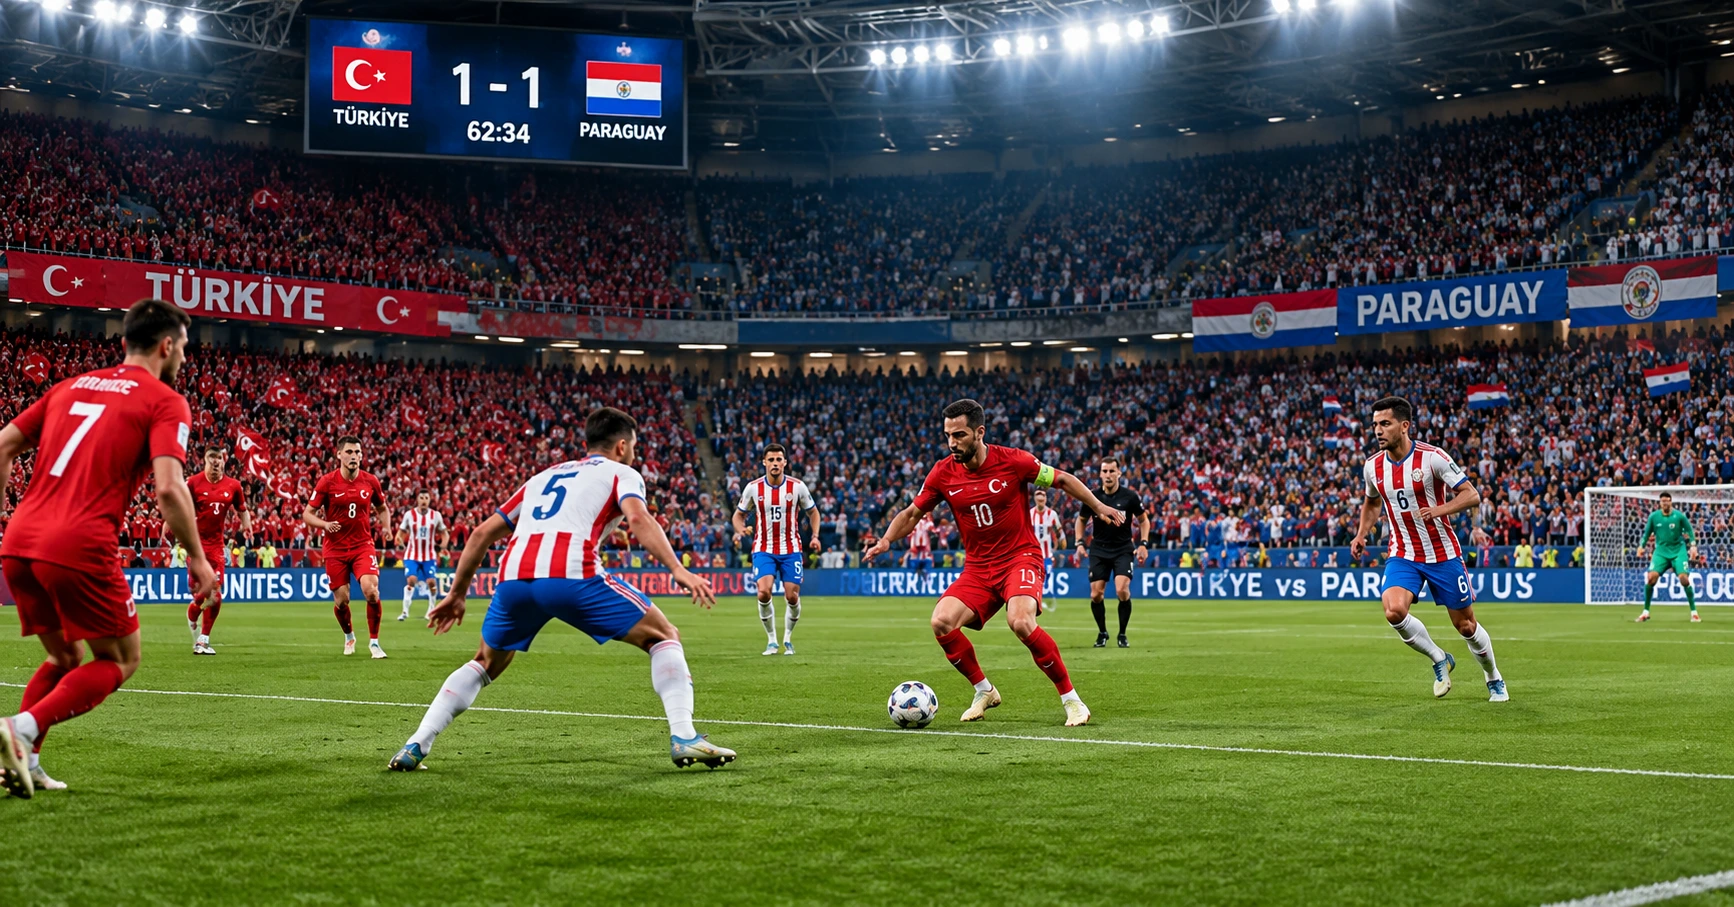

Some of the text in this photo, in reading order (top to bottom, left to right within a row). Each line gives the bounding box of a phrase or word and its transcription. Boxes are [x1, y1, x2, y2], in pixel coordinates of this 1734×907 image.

[452, 62, 471, 105] 1
[521, 66, 540, 109] 1
[332, 106, 410, 129] TÜRKİYE
[466, 120, 531, 144] 62:34
[579, 121, 667, 141] PARAGUAY
[145, 268, 325, 322] TÜRKİYE
[1356, 280, 1544, 327] PARAGUAY
[49, 401, 107, 477] 7
[532, 471, 580, 520] 5
[1396, 490, 1410, 510] 6
[348, 502, 357, 519] 8
[770, 506, 782, 520] 15
[970, 503, 994, 528] 10
[1457, 575, 1468, 594] 6
